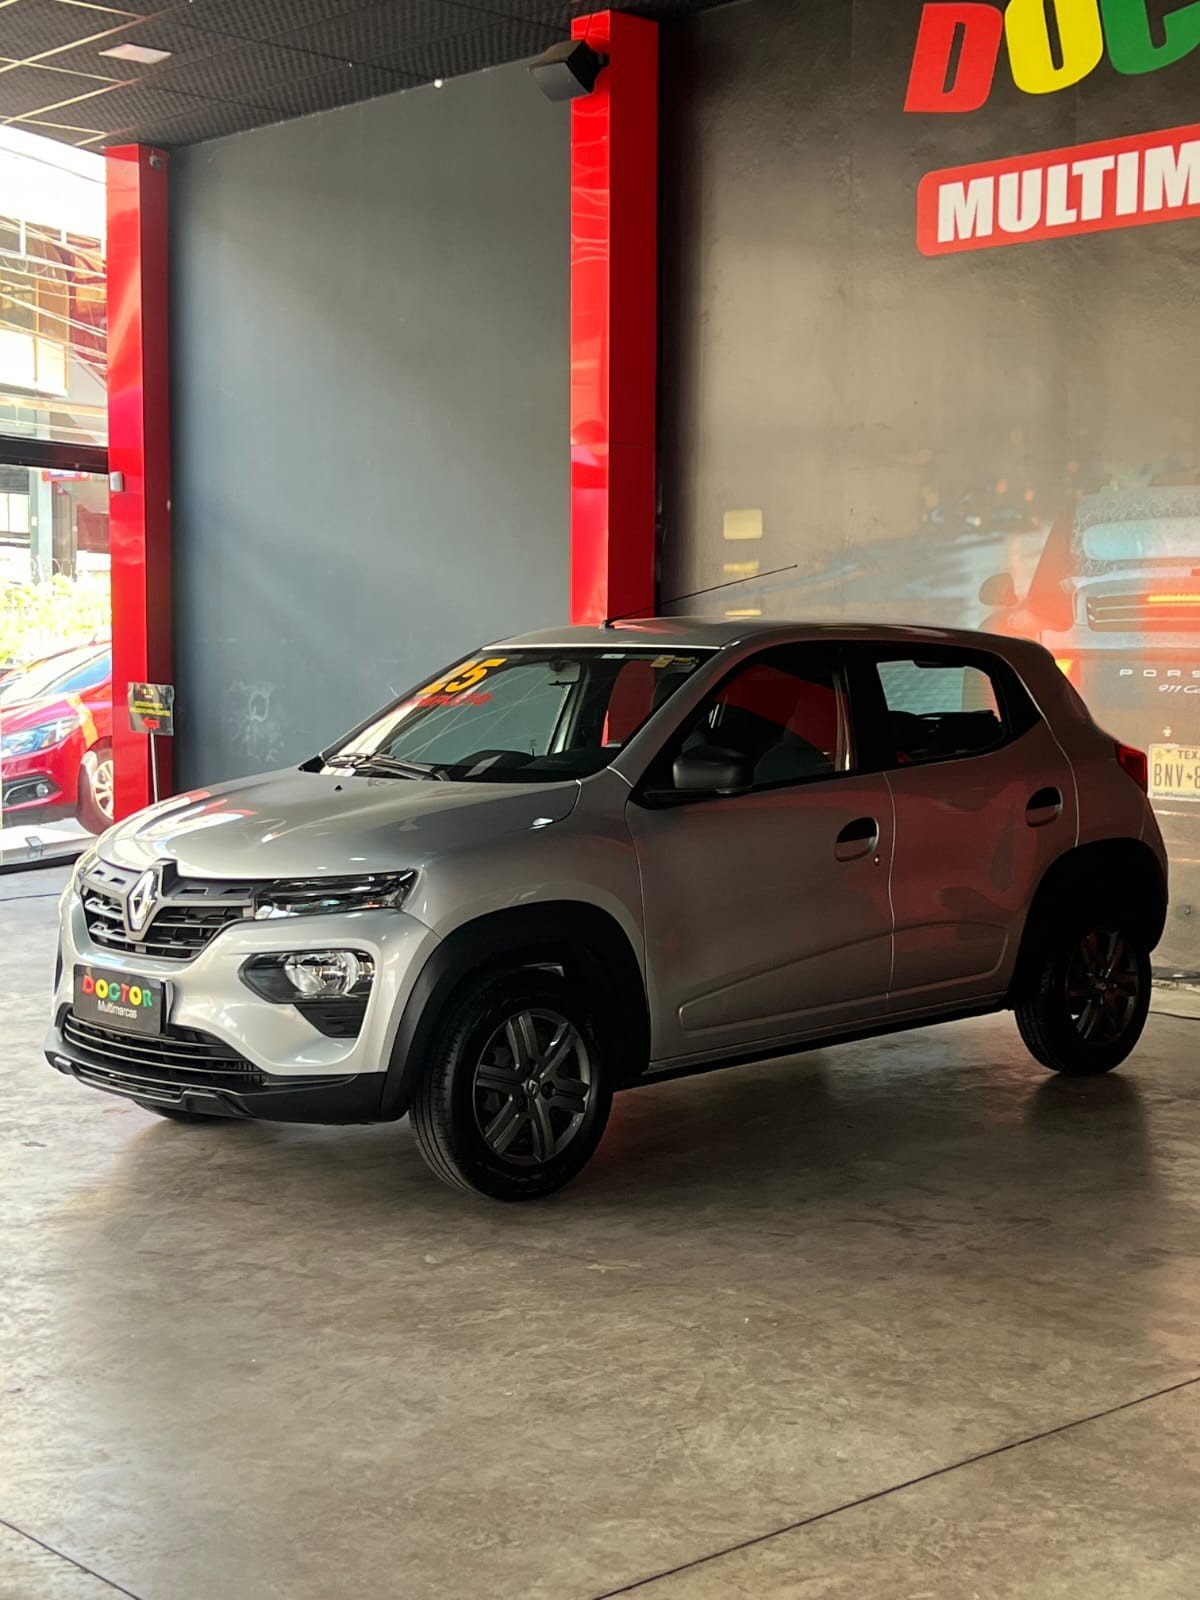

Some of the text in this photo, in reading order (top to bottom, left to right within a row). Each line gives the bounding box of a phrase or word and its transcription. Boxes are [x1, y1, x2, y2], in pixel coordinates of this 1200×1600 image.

[937, 140, 1200, 243] MULTIM
[1177, 750, 1200, 760] TEX
[82, 974, 152, 1008] DOCTOR
